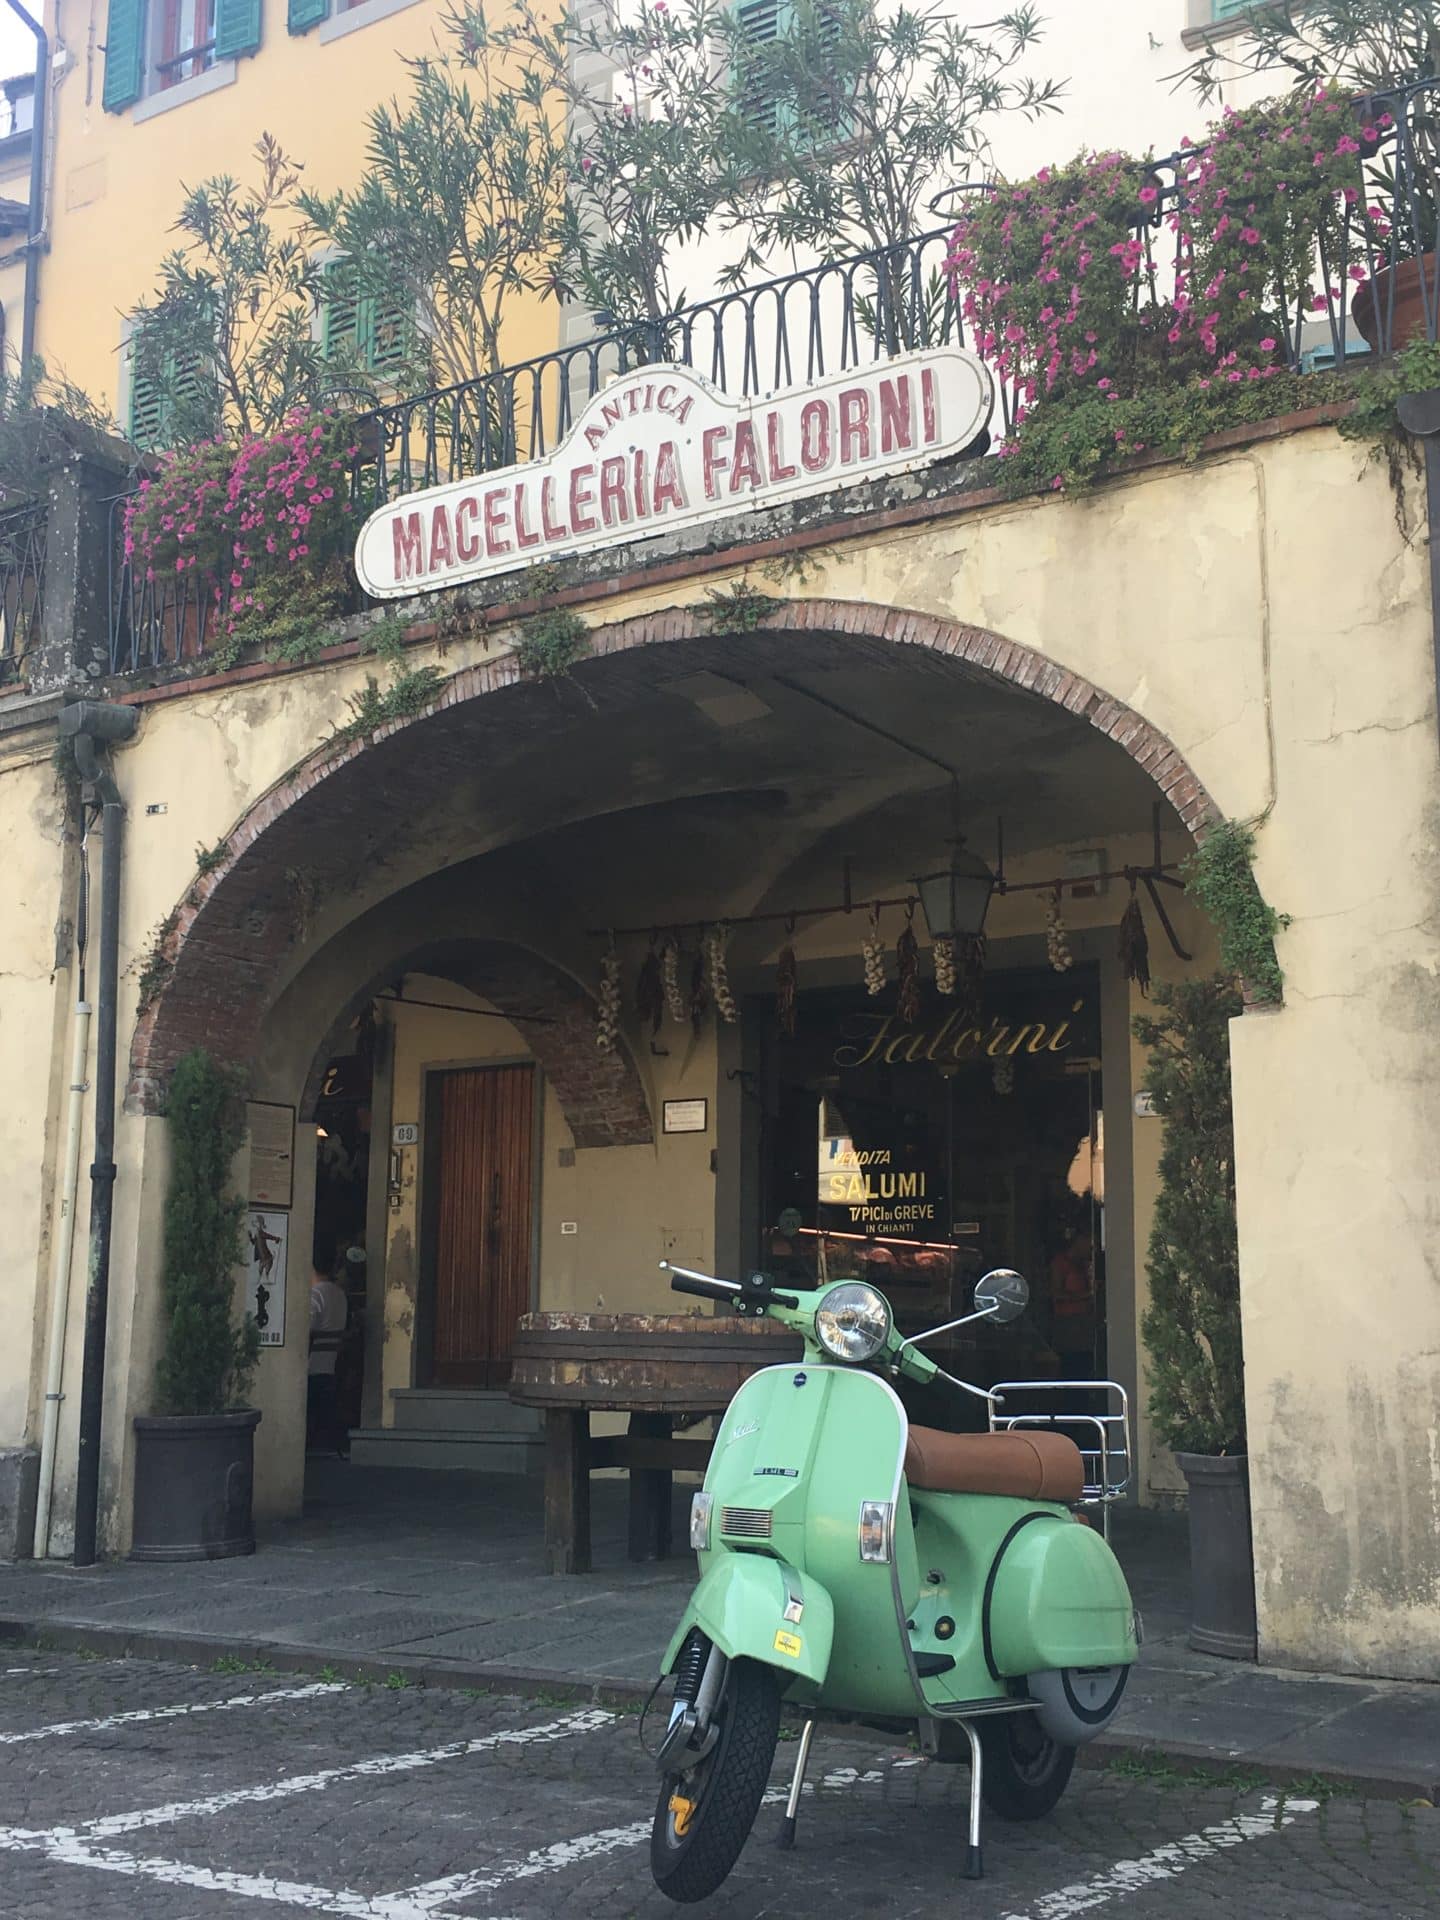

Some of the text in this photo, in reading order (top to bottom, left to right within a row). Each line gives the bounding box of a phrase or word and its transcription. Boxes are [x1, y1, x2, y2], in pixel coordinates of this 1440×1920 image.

[584, 384, 695, 452] ANTICA
[391, 368, 939, 582] MACELLERIA FALORNI
[834, 1000, 1083, 1067] Falorni
[833, 1150, 891, 1166] VENDITA
[830, 1172, 925, 1200] SALUMI
[894, 1205, 934, 1220] GREVE
[866, 1224, 914, 1233] IN CHIANTI
